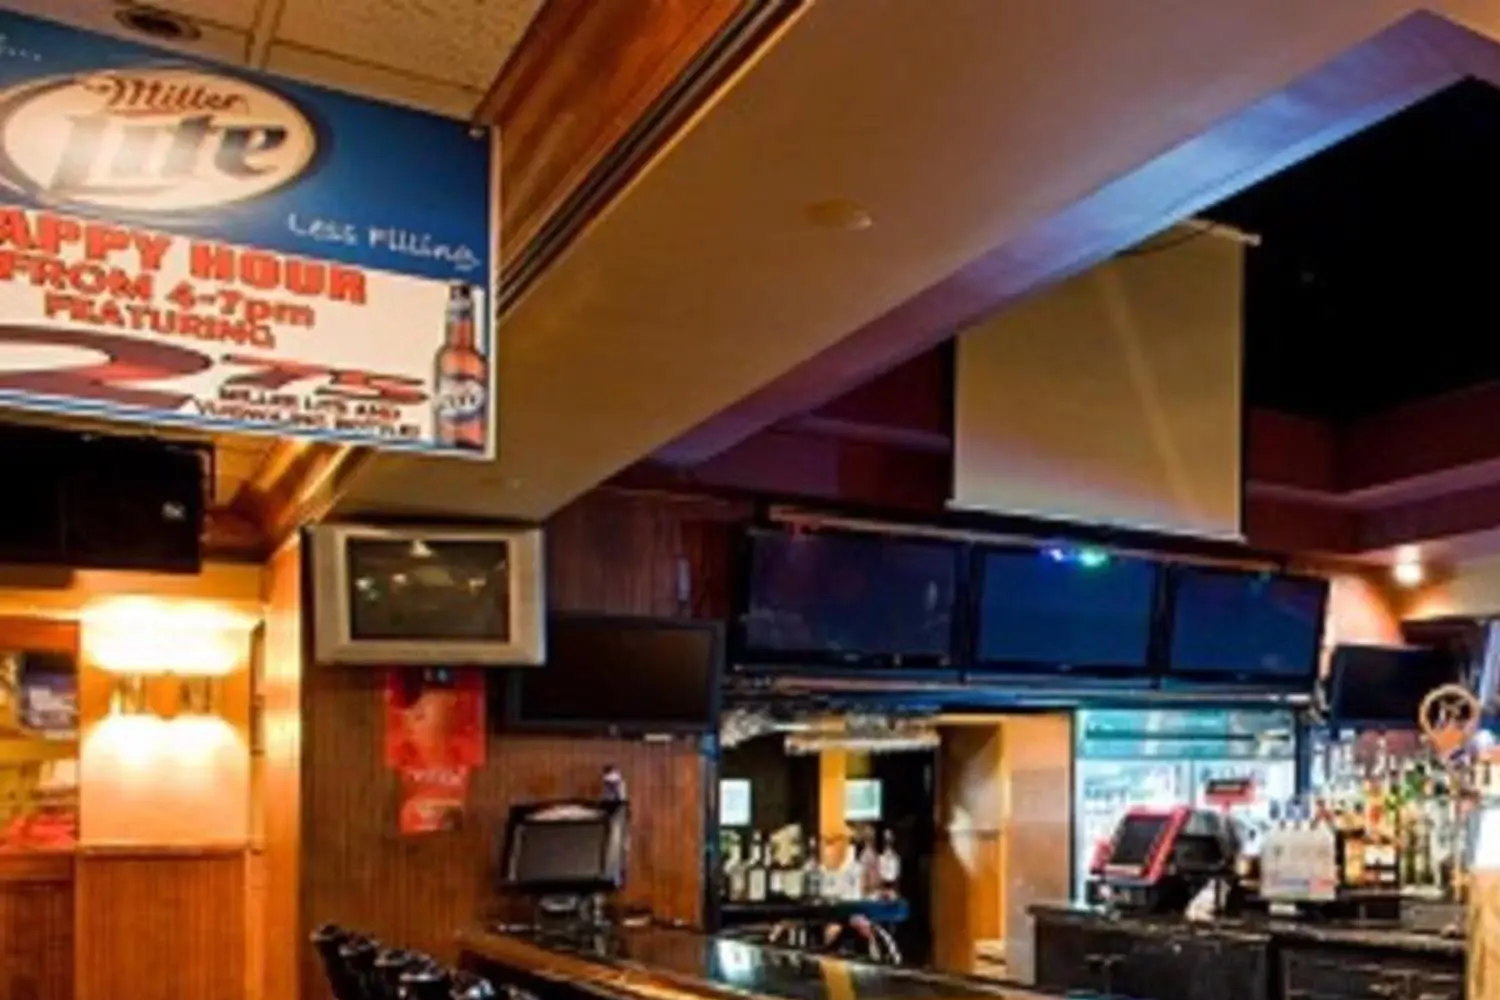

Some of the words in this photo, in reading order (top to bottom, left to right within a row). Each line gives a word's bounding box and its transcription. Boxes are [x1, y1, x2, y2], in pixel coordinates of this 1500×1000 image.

[82, 74, 248, 116] Miller
[50, 112, 288, 190] Lite
[0, 206, 172, 271] APPY
[190, 243, 367, 305] HOUR
[0, 250, 153, 301] FROM
[45, 292, 276, 349] FEATURING
